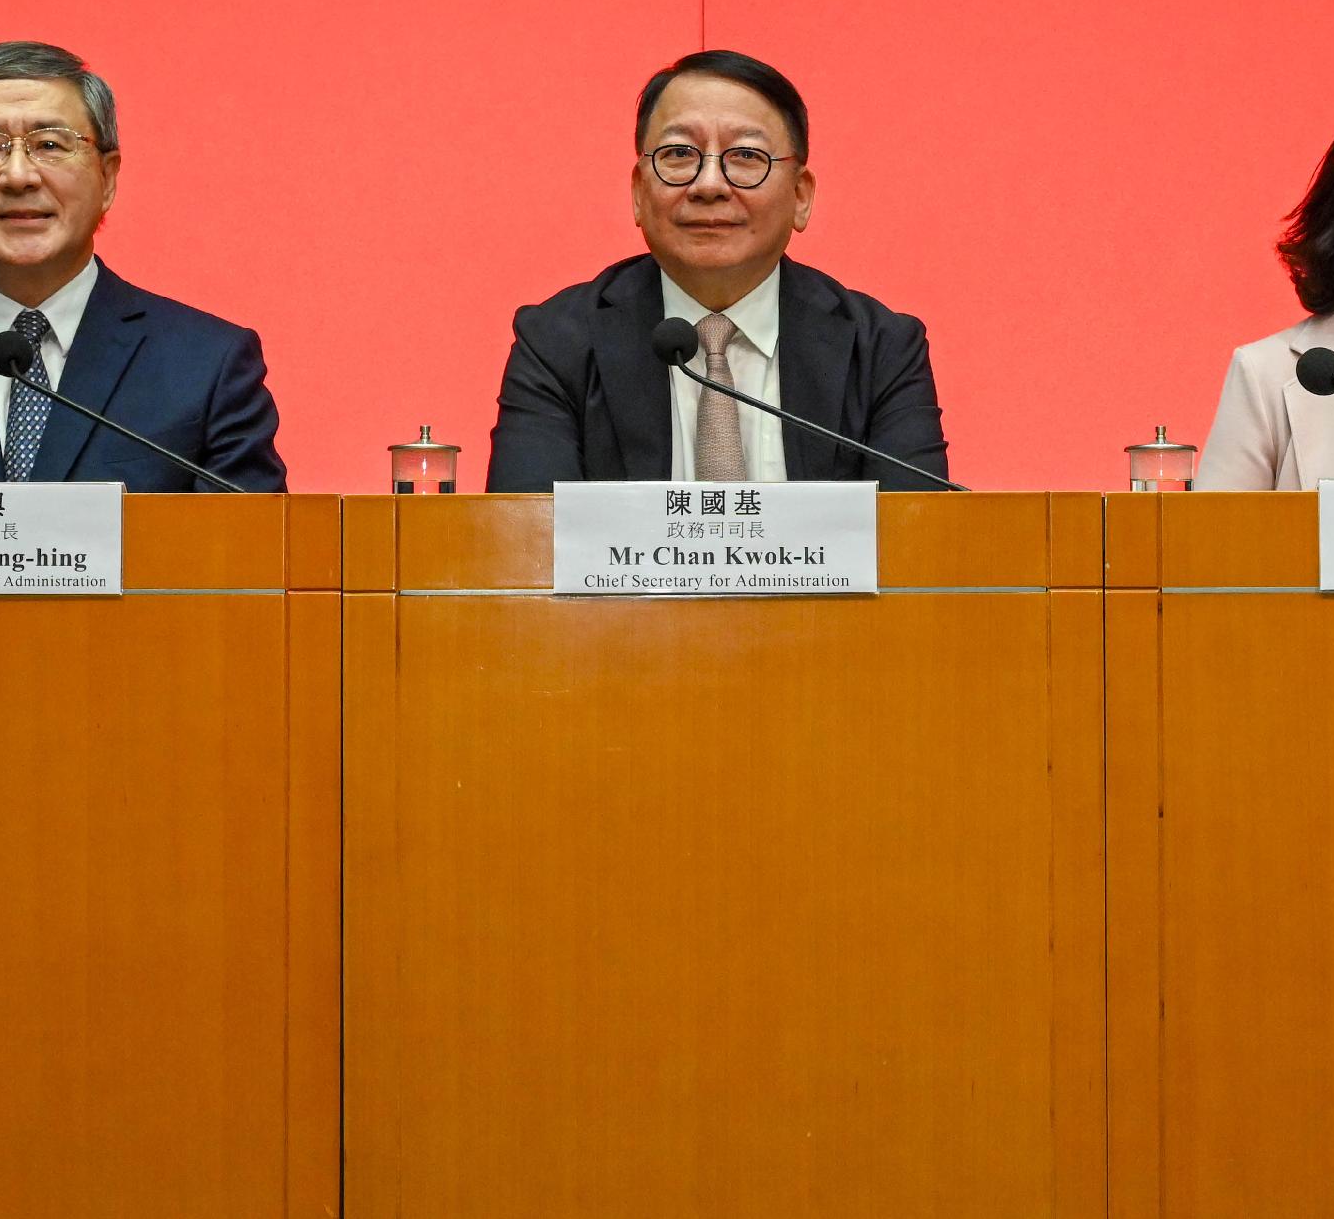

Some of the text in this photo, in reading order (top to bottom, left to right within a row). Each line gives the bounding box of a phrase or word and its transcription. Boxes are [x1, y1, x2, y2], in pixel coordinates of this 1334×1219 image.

[666, 489, 762, 516] 陳國基
[667, 521, 765, 539] 政務司司長
[608, 546, 826, 566] Mr Chan Kwok-ki
[3, 575, 106, 587] Administration
[584, 574, 850, 589] Chief Secretary for Administration
